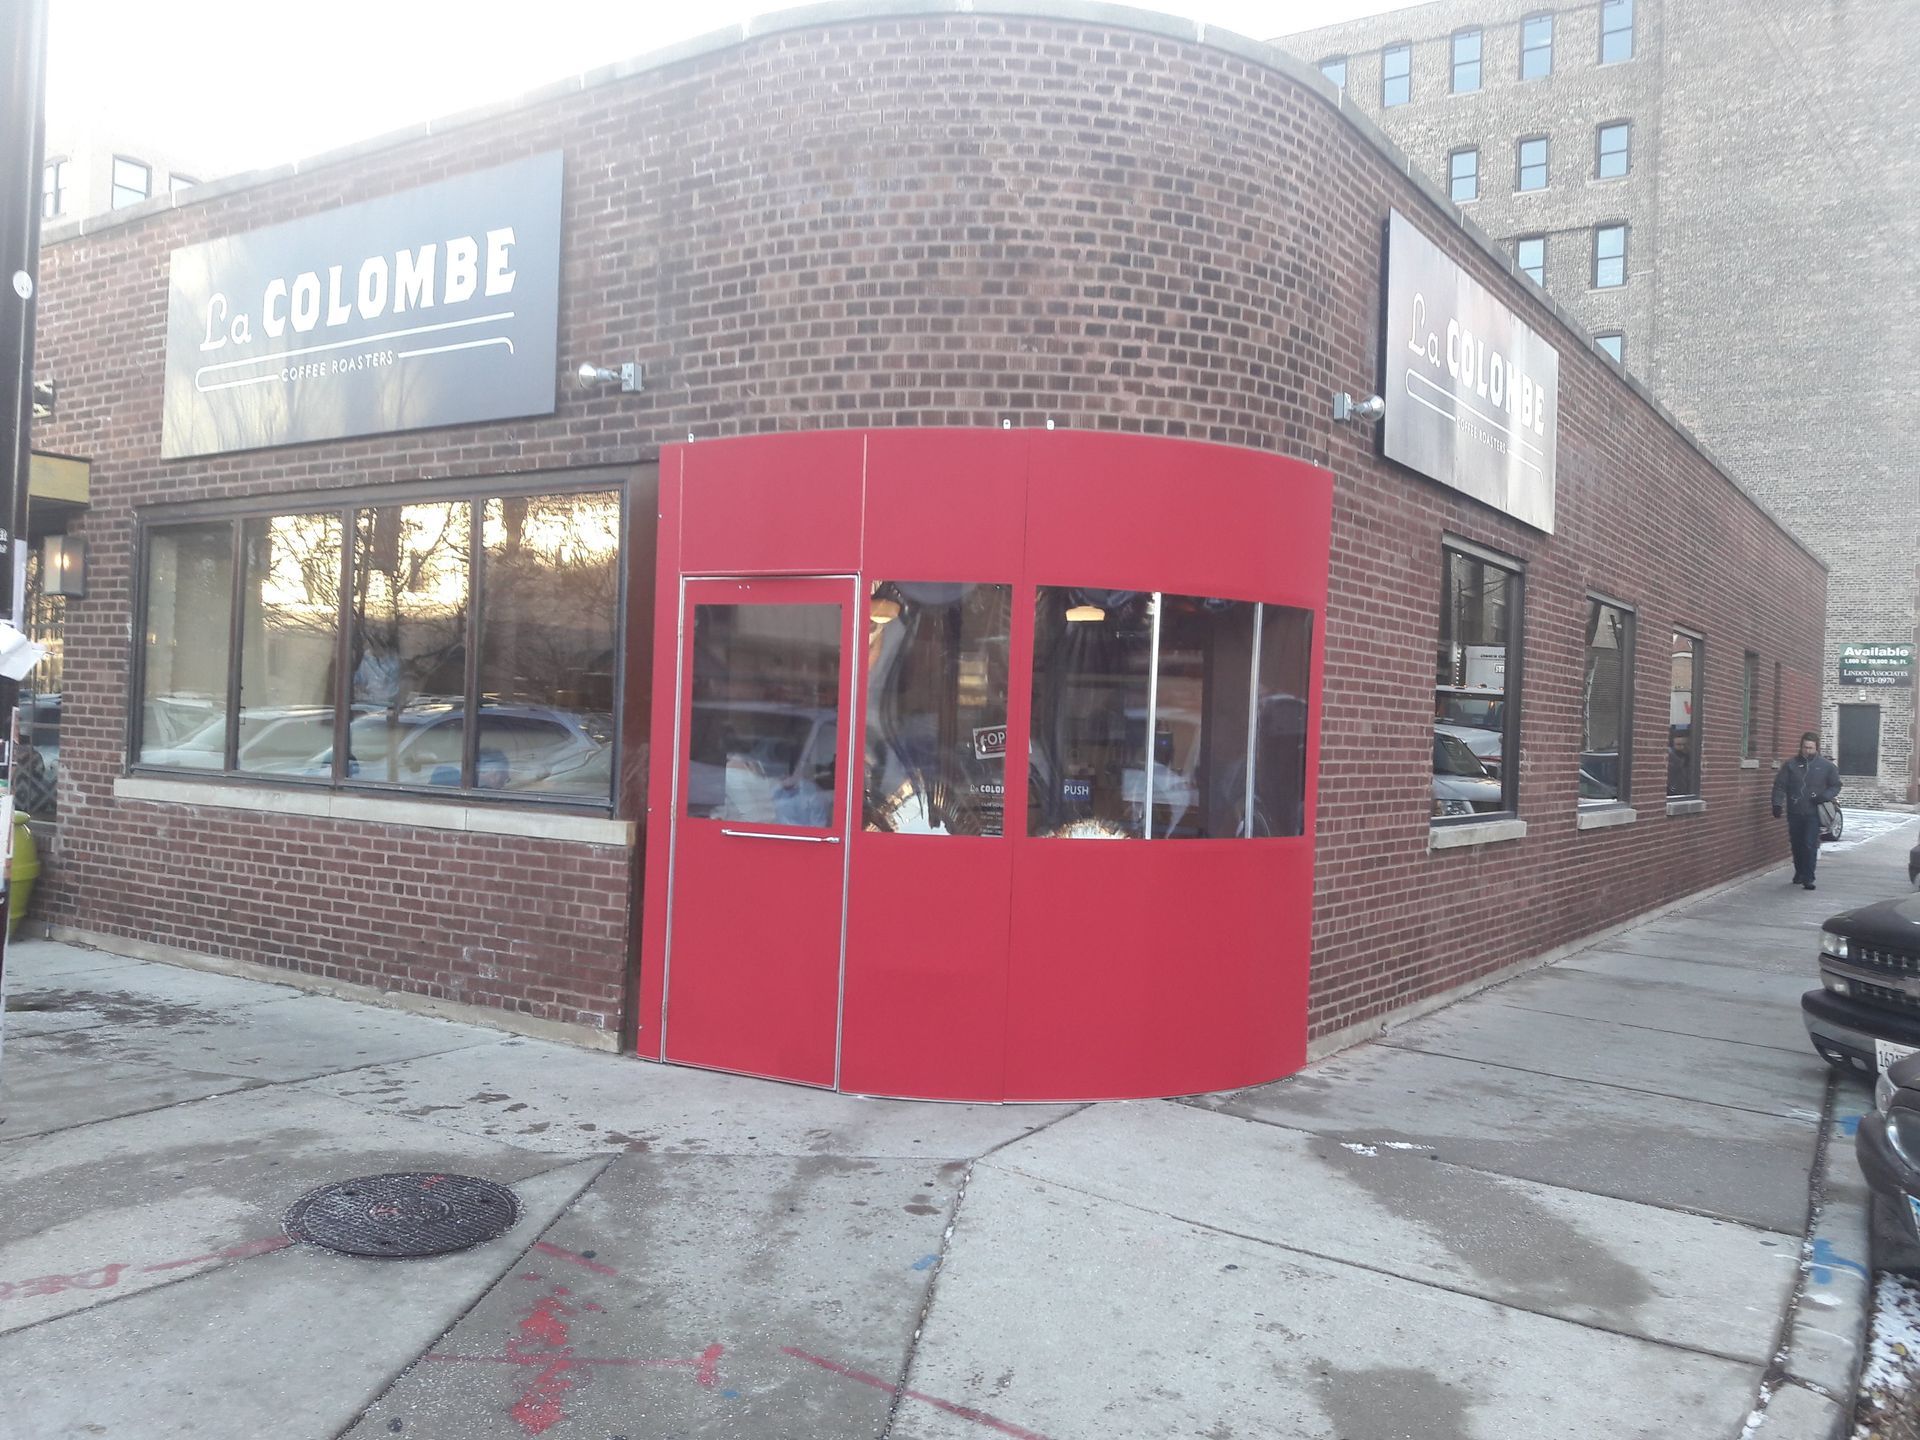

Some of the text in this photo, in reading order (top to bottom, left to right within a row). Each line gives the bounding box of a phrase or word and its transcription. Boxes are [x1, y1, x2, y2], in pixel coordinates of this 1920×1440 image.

[199, 226, 517, 352] La COLOMBE
[281, 350, 394, 383] COFFEE ROASTERS
[1408, 292, 1545, 436] La COLOMBE
[1456, 415, 1507, 455] COFFEE ROASTERS
[1844, 646, 1909, 657] Available
[987, 731, 1007, 746] OP
[1063, 784, 1089, 796] PUSH
